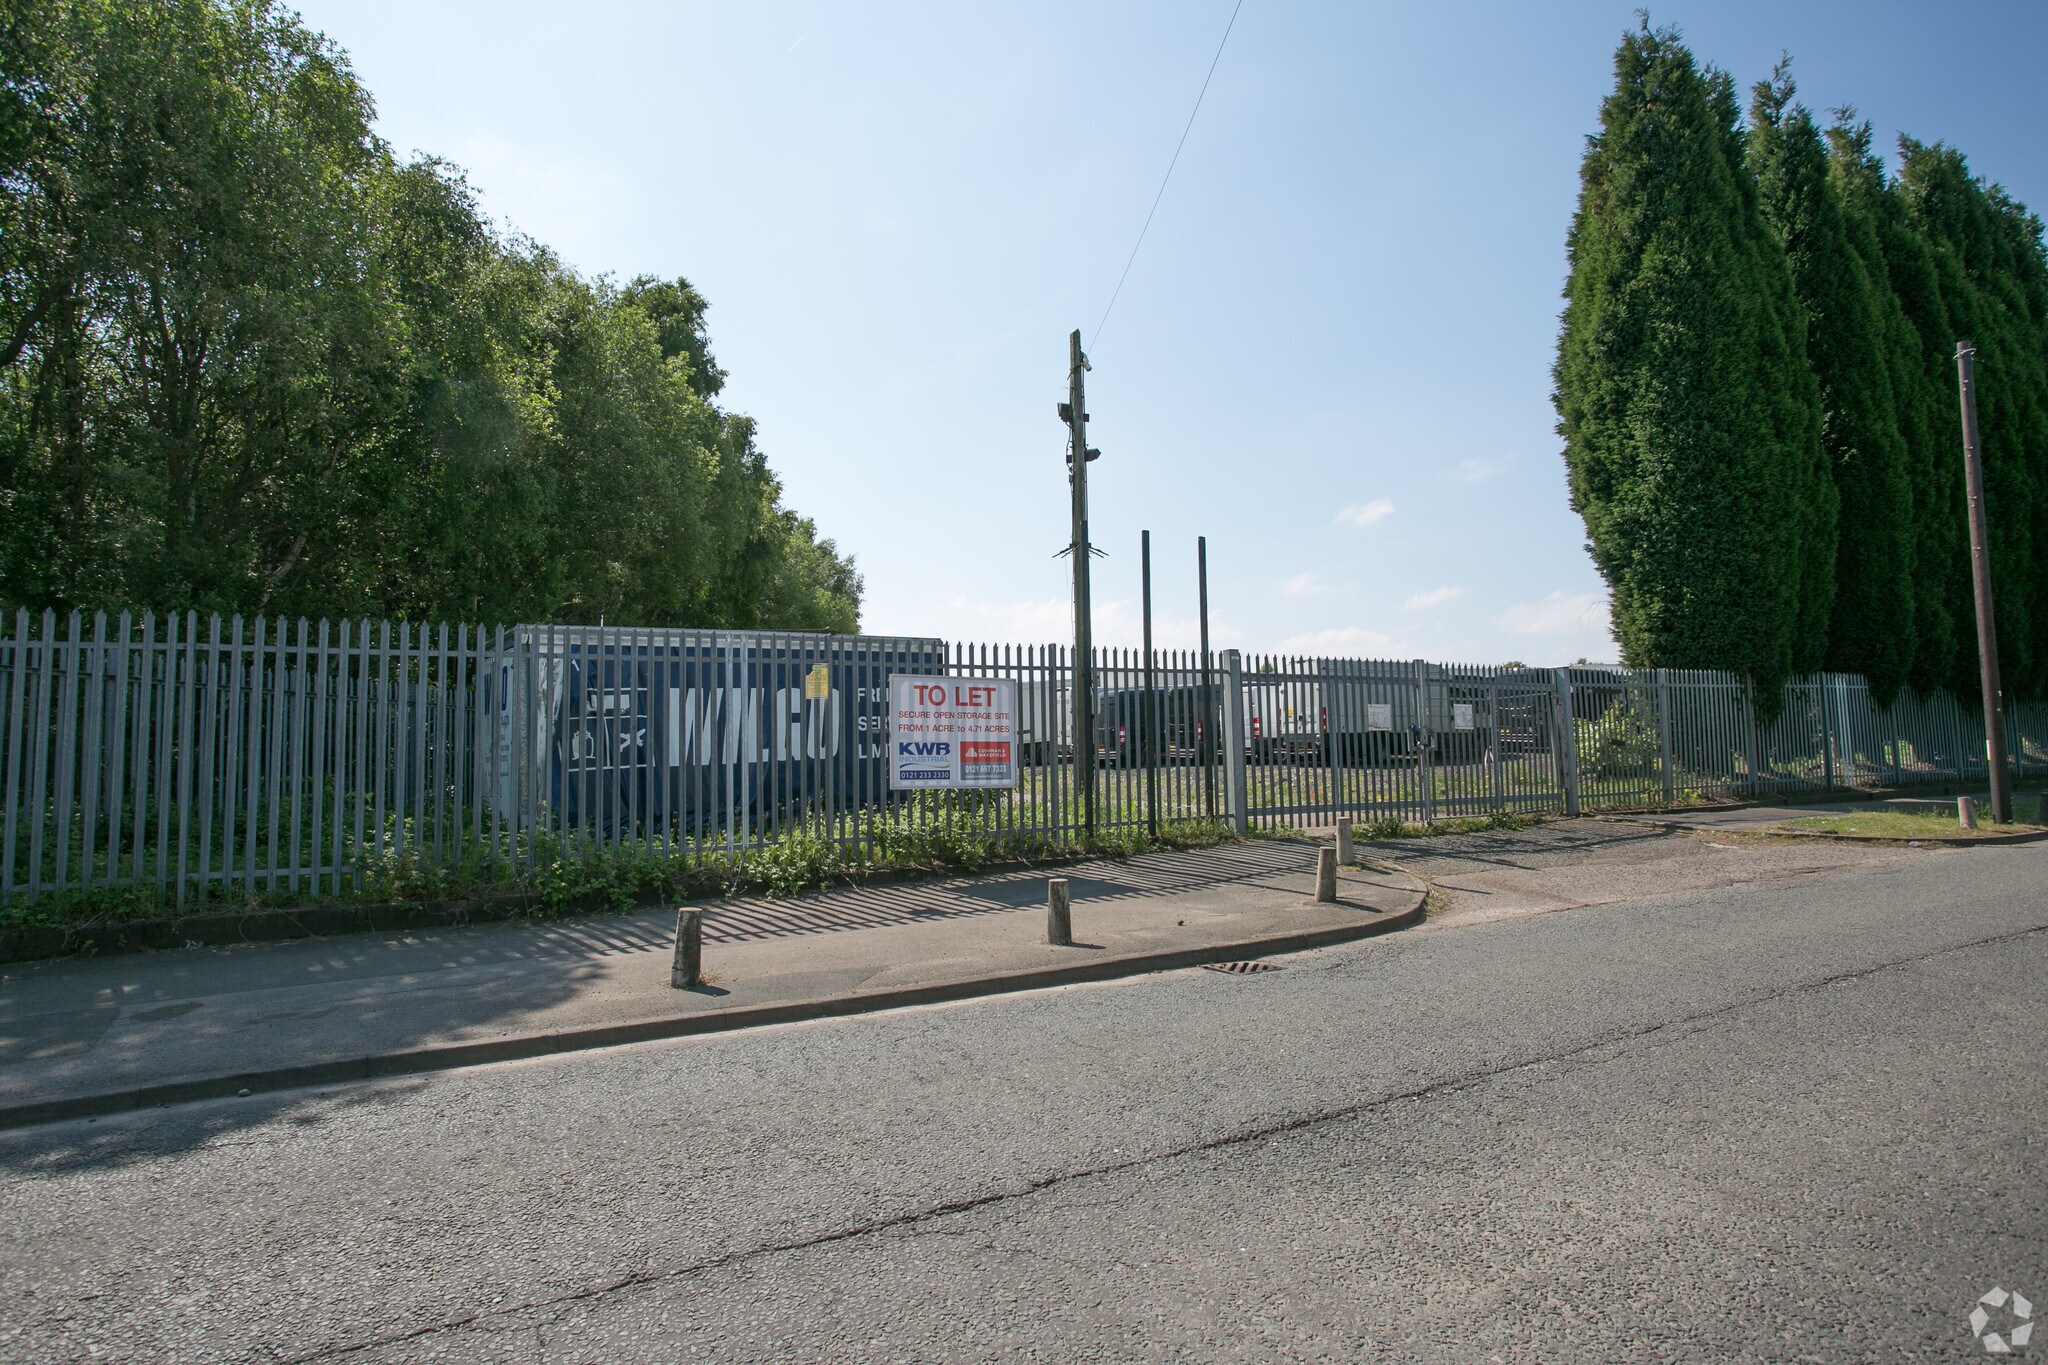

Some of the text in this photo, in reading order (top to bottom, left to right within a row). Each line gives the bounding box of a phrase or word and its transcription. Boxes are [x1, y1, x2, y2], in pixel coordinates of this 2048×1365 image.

[913, 685, 996, 707] TO LET
[898, 711, 930, 719] SECURE
[934, 711, 955, 719] OPEN
[957, 712, 992, 720] STORAGE
[898, 724, 1010, 733] FROM 1 ACRE to 4.71 ACRES
[899, 742, 951, 756] KWB
[899, 755, 950, 763] INDUSTRIAL
[965, 765, 979, 773] 0121
[980, 765, 991, 773] 697
[901, 771, 949, 779] 0121 233 2330
